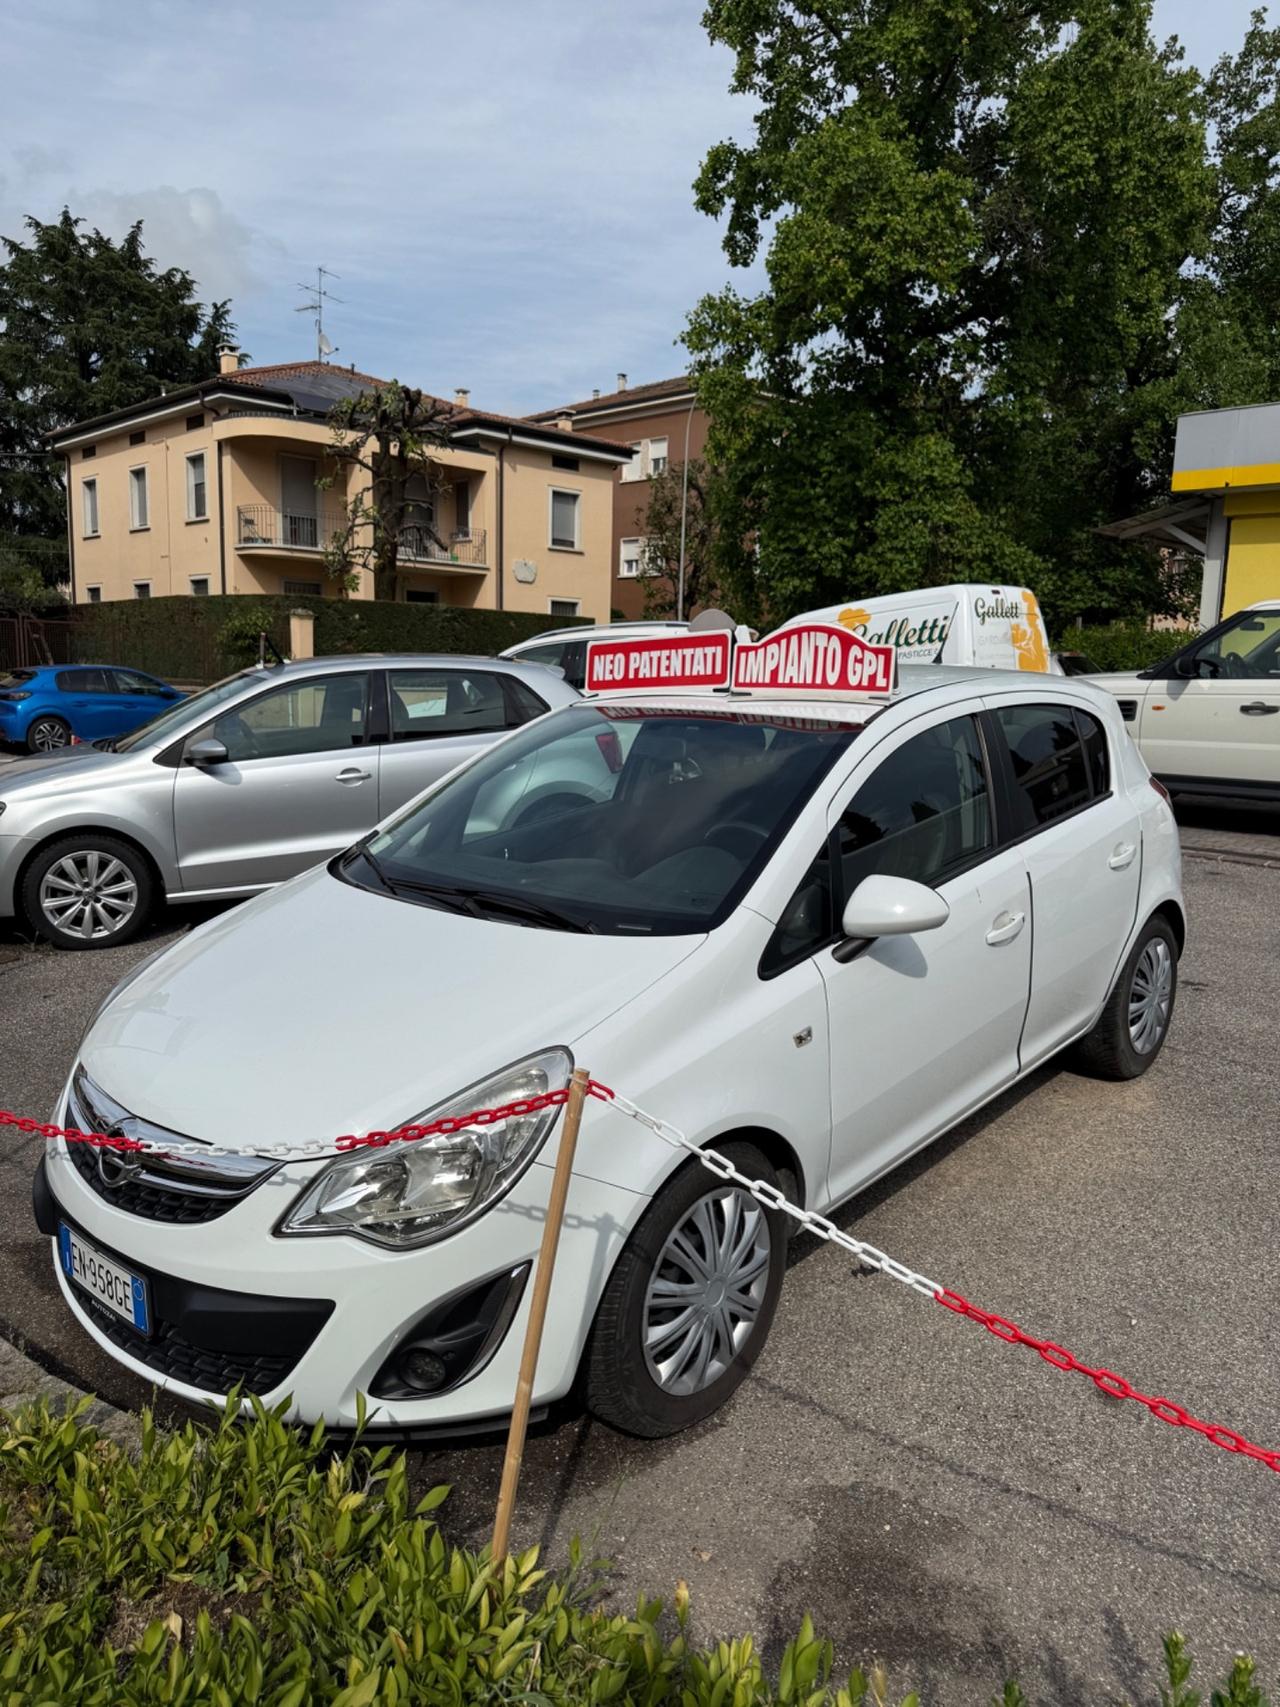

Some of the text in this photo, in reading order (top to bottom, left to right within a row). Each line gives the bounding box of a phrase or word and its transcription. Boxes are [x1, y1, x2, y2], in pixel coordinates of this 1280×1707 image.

[593, 645, 723, 682] NEO PATENTATI
[738, 631, 887, 687] IMPIANTO GPL
